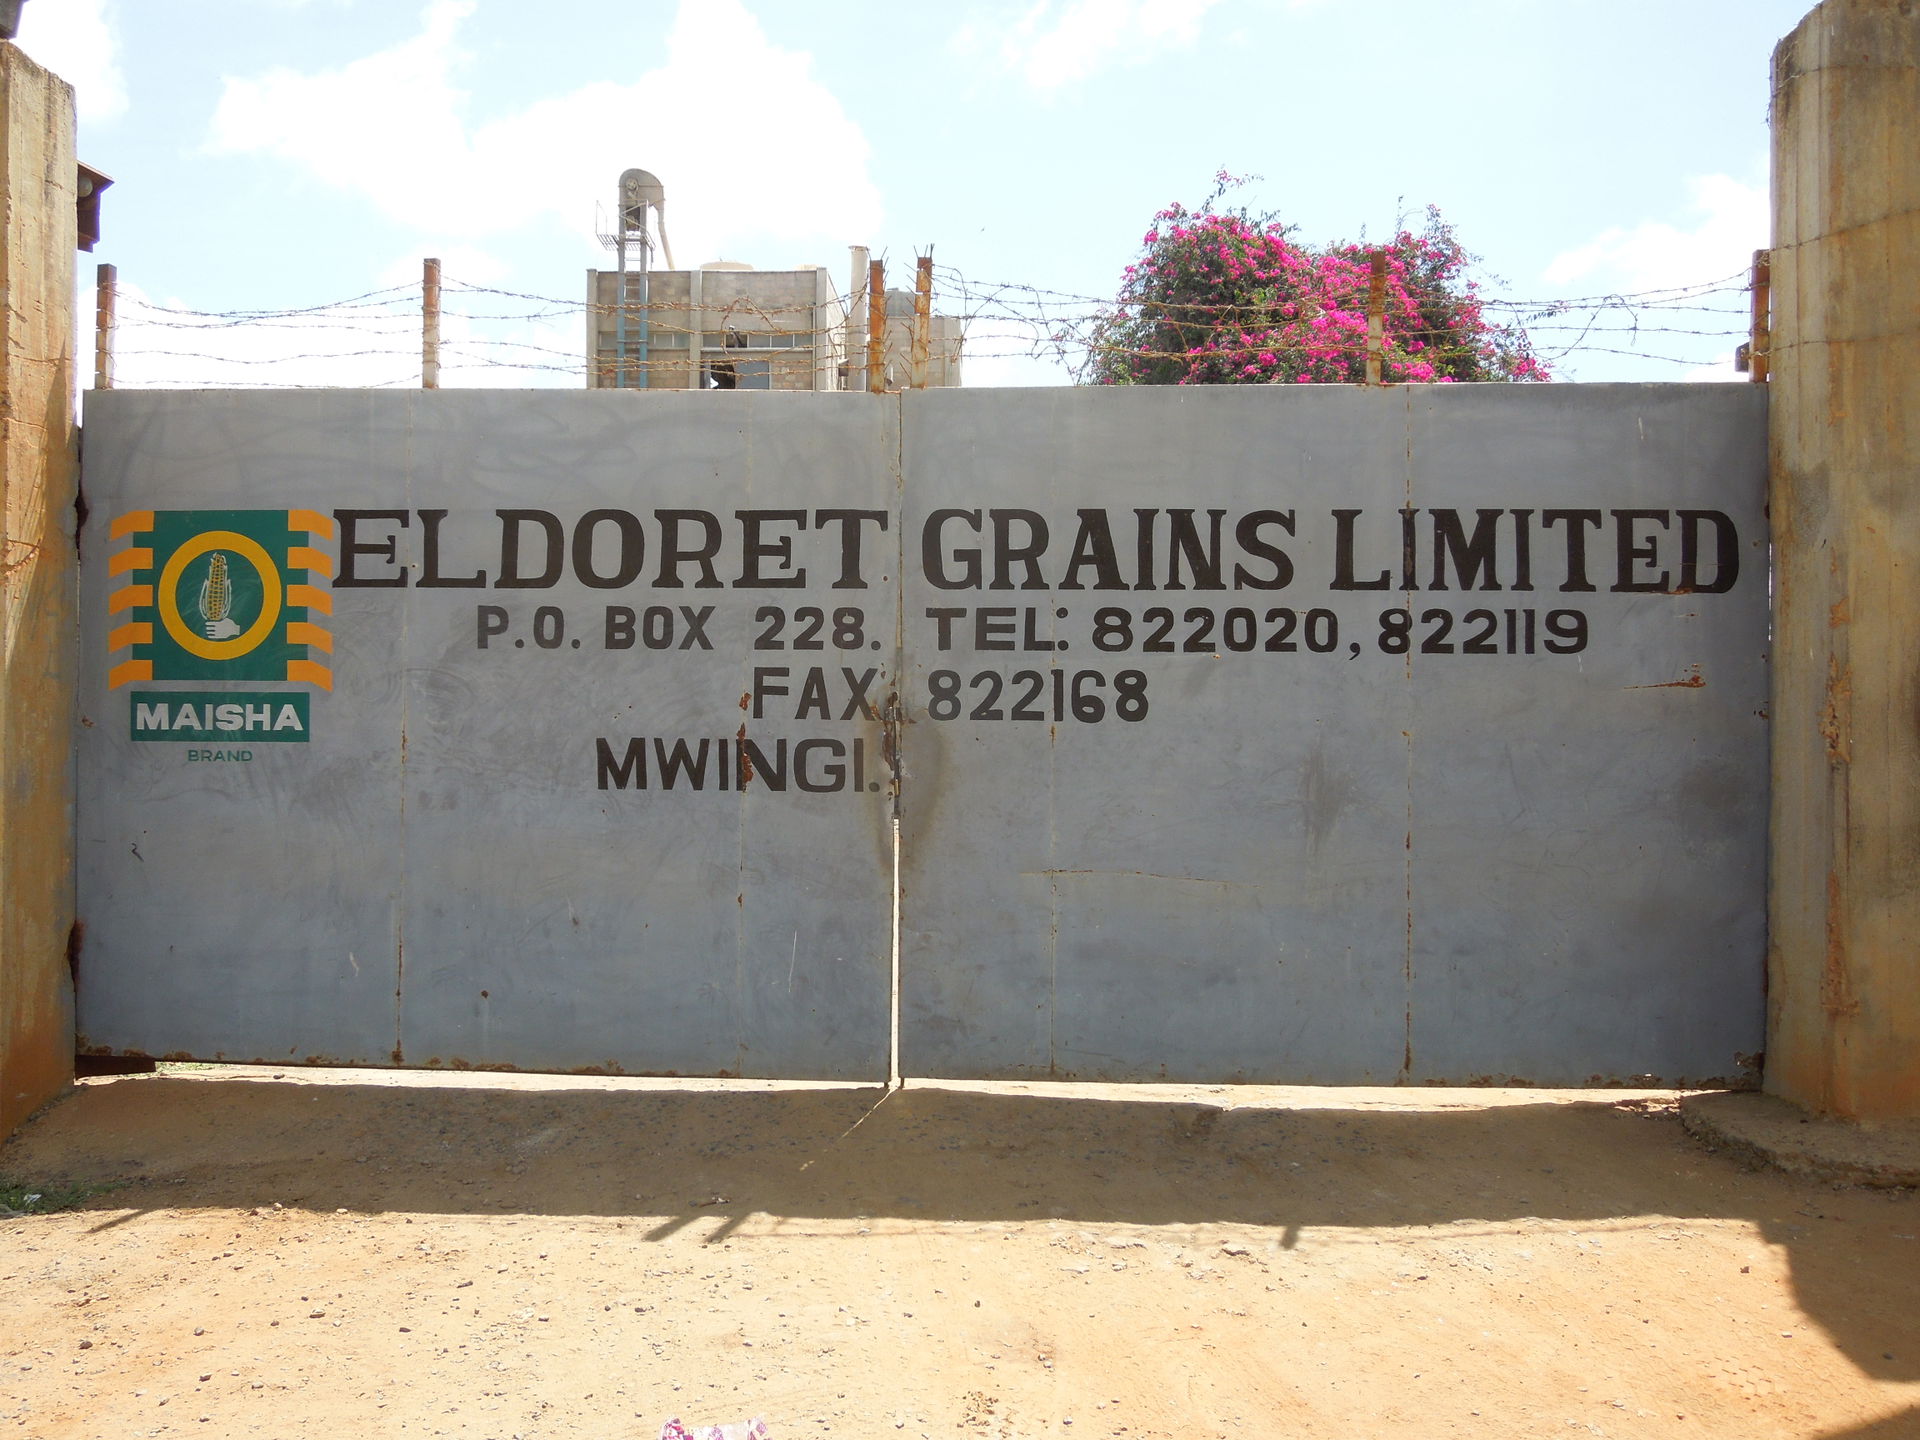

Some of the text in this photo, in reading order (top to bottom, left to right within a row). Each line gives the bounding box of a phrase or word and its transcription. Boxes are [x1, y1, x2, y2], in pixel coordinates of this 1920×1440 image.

[332, 508, 1740, 594] ELDORET GRAINS LIMITED
[604, 606, 716, 650] BOX
[753, 606, 883, 651] 228.
[925, 606, 1070, 652] TEL:
[136, 703, 303, 731] MAISHA
[751, 666, 1149, 724] FAX 822168
[187, 749, 254, 763] BRAND
[595, 737, 882, 793] MWINGI.
